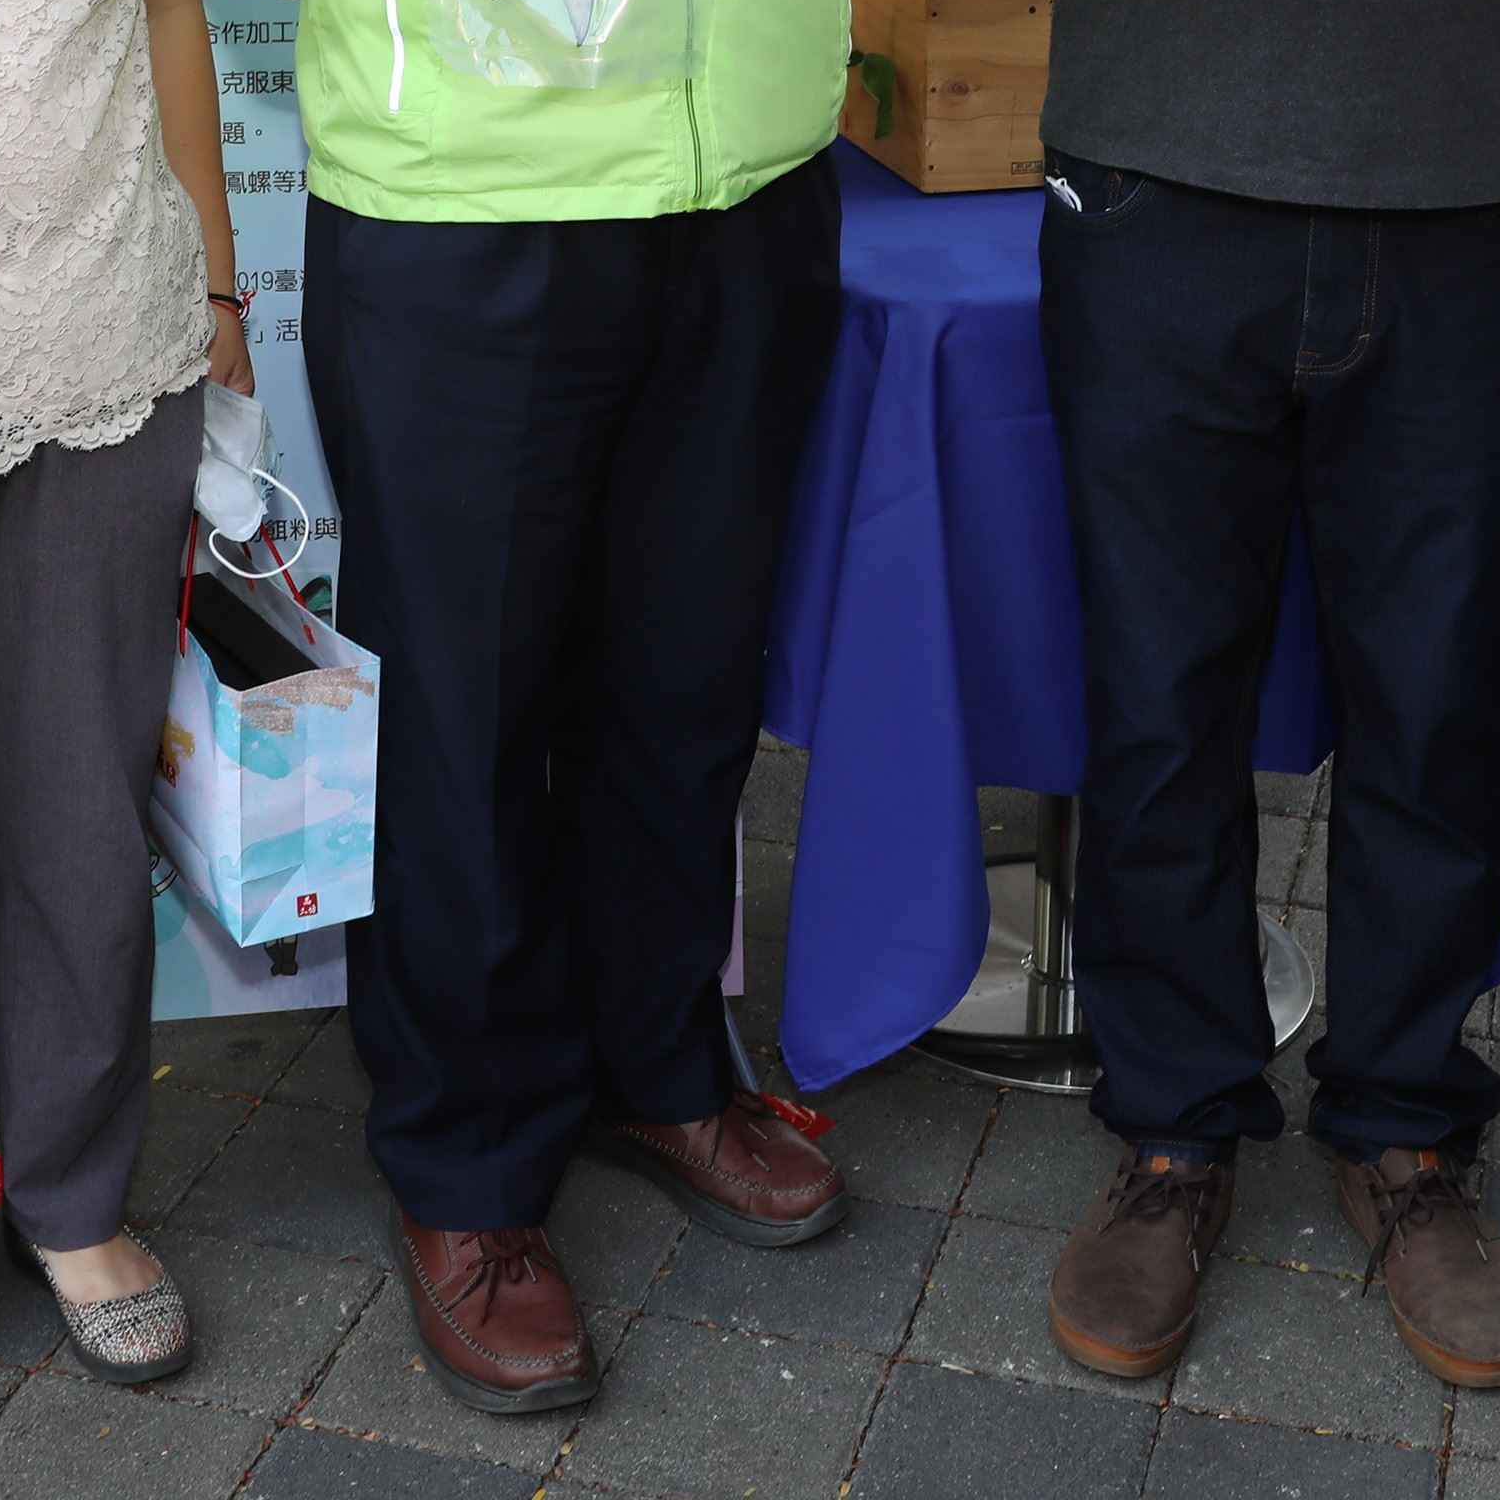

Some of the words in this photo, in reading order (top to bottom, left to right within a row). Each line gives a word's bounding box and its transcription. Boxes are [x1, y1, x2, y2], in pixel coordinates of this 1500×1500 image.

[207, 20, 300, 45] 合作加工
[221, 70, 295, 94] 克服東
